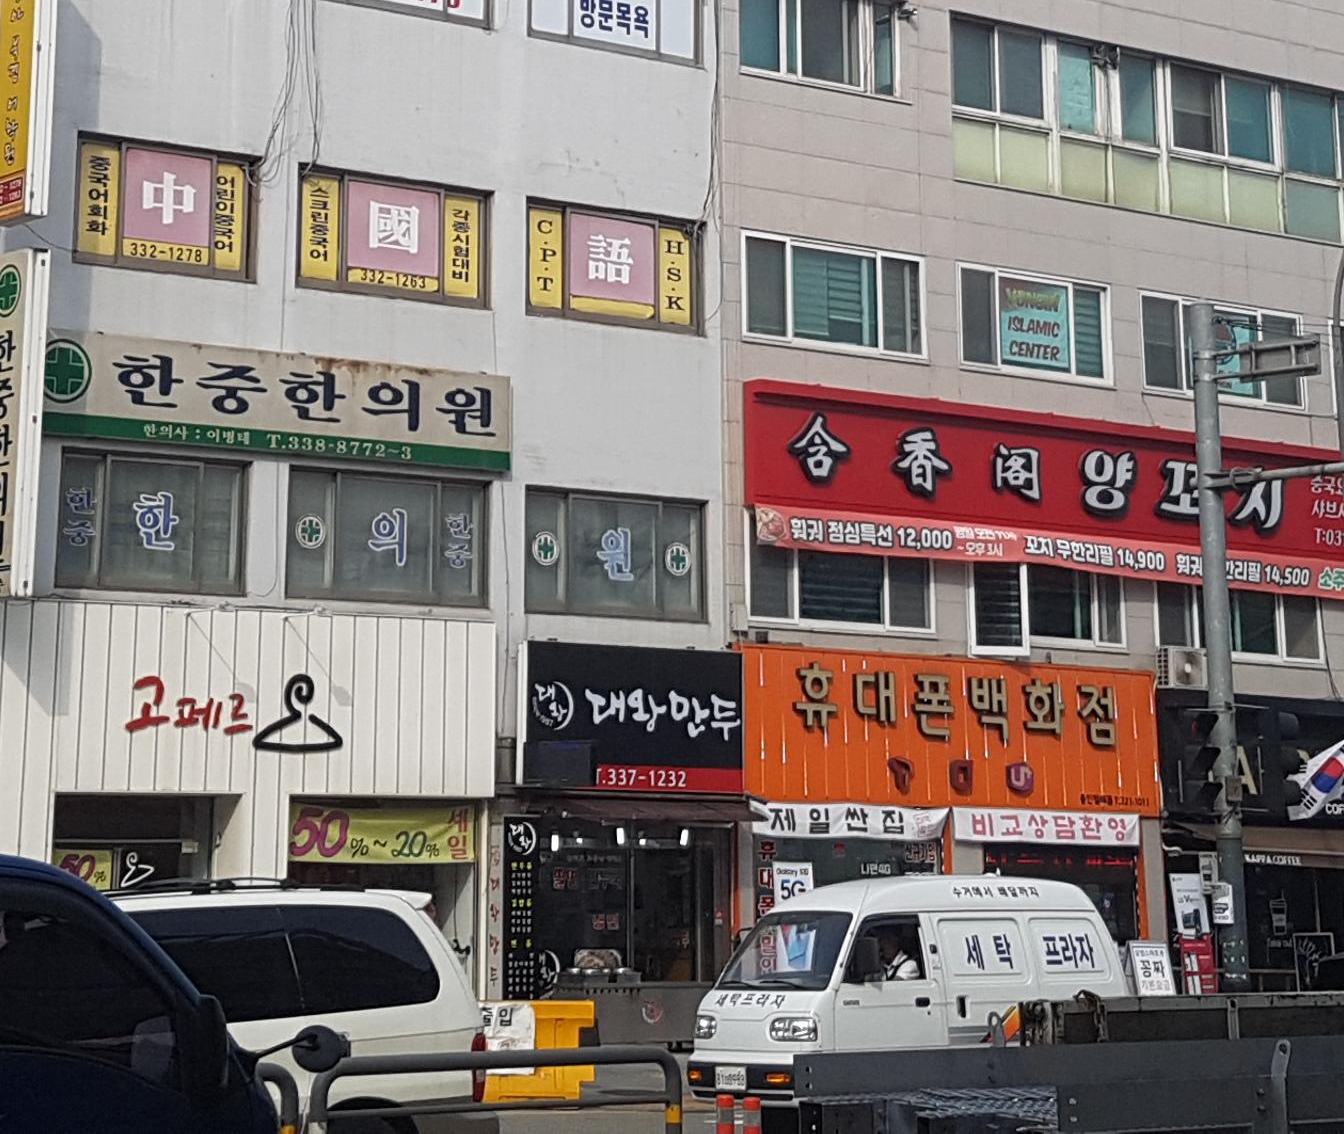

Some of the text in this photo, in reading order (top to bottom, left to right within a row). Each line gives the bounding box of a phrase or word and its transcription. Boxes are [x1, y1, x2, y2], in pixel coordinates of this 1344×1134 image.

[142, 171, 197, 225] 中
[309, 186, 330, 262] 스크린중국어
[130, 242, 202, 263] 332-1278
[369, 200, 420, 254] 國
[452, 209, 471, 283] 각종시험대비
[361, 268, 426, 289] 332-1263
[587, 234, 634, 284] 語
[1008, 316, 1060, 338] ISLAMIC
[1009, 340, 1060, 362] CENTER
[112, 353, 497, 439] 한중한의원
[144, 423, 188, 440] 한의사
[63, 487, 96, 547] 한중
[132, 491, 180, 551] 한
[368, 508, 407, 567] 의
[443, 513, 474, 569] 한중
[596, 527, 635, 582] 원
[789, 517, 823, 542] 훠궈
[828, 521, 893, 548] 점심특선
[898, 528, 952, 551] 12,000
[1056, 539, 1114, 567] 무한리필
[1117, 547, 1165, 571] 14,900
[1176, 553, 1203, 577] 훠궈
[1265, 565, 1310, 587] 14,500
[125, 674, 254, 737] 고페르
[585, 688, 741, 741] 대왕만두
[795, 662, 1117, 746] 휴대폰백화점
[447, 809, 469, 861] 세일
[768, 806, 905, 835] 제일싼집
[971, 813, 1128, 842] 비교상담환영
[966, 932, 1096, 971] 세탁 프라자
[716, 994, 786, 1009] 세탁프라자
